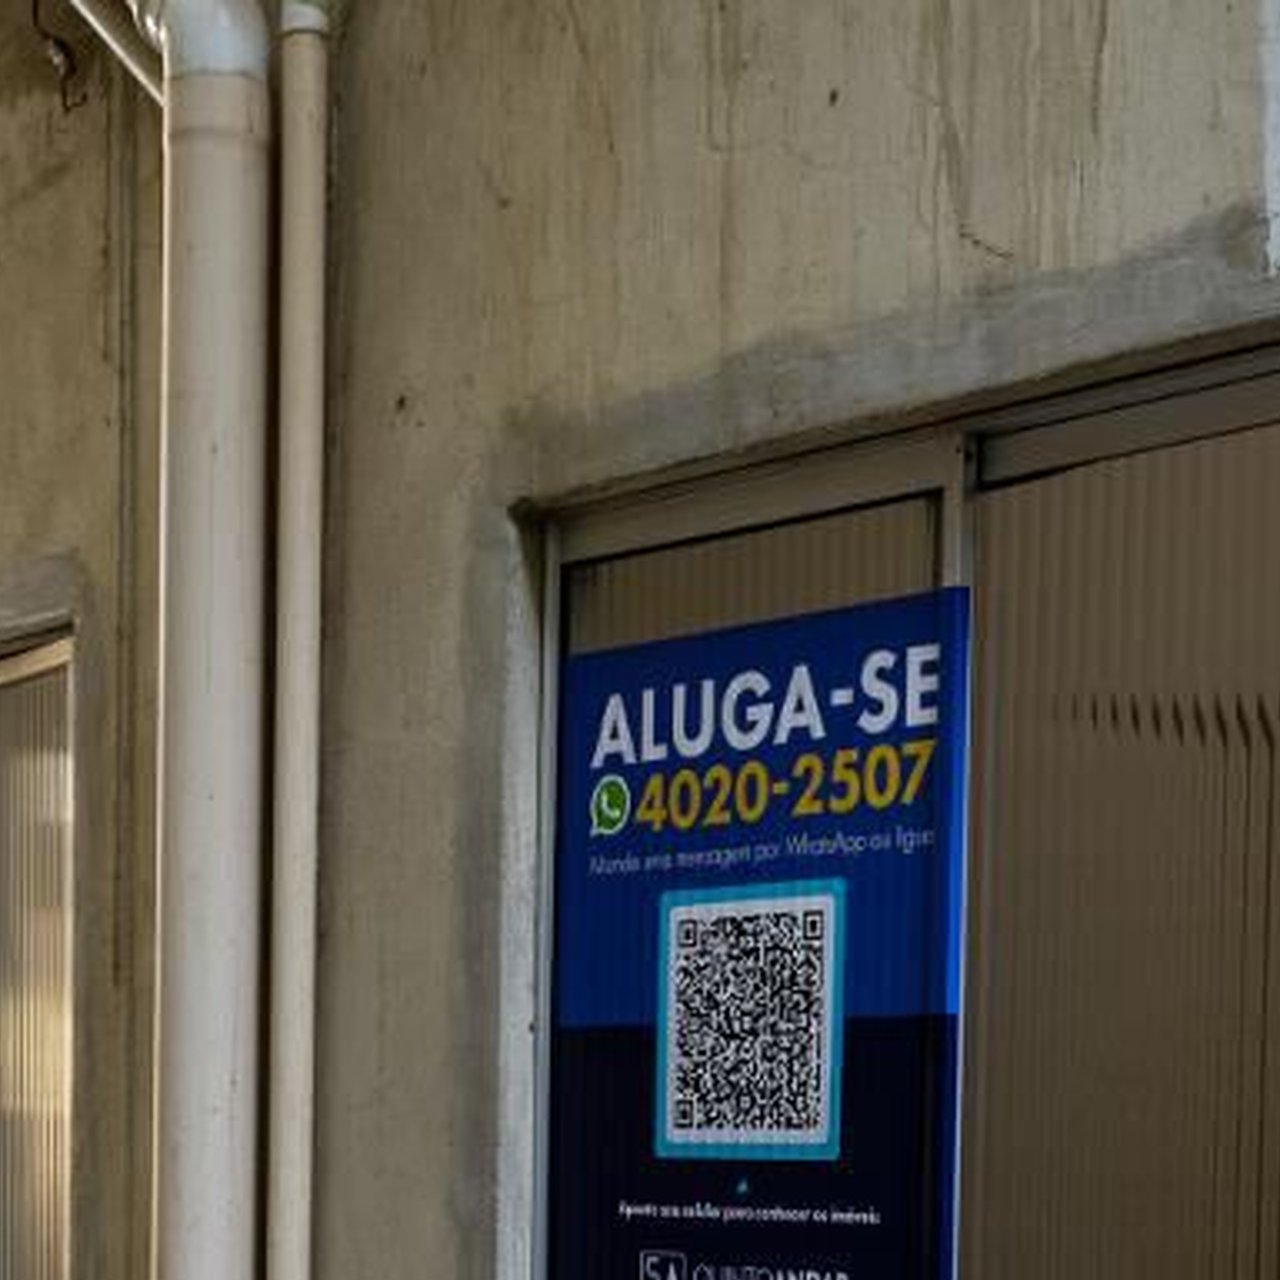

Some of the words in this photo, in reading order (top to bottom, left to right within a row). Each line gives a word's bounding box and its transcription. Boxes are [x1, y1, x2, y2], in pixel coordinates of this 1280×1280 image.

[590, 642, 941, 769] ALUGA-SE
[634, 739, 937, 832] 4020-2507
[785, 830, 867, 857] WhatsApp
